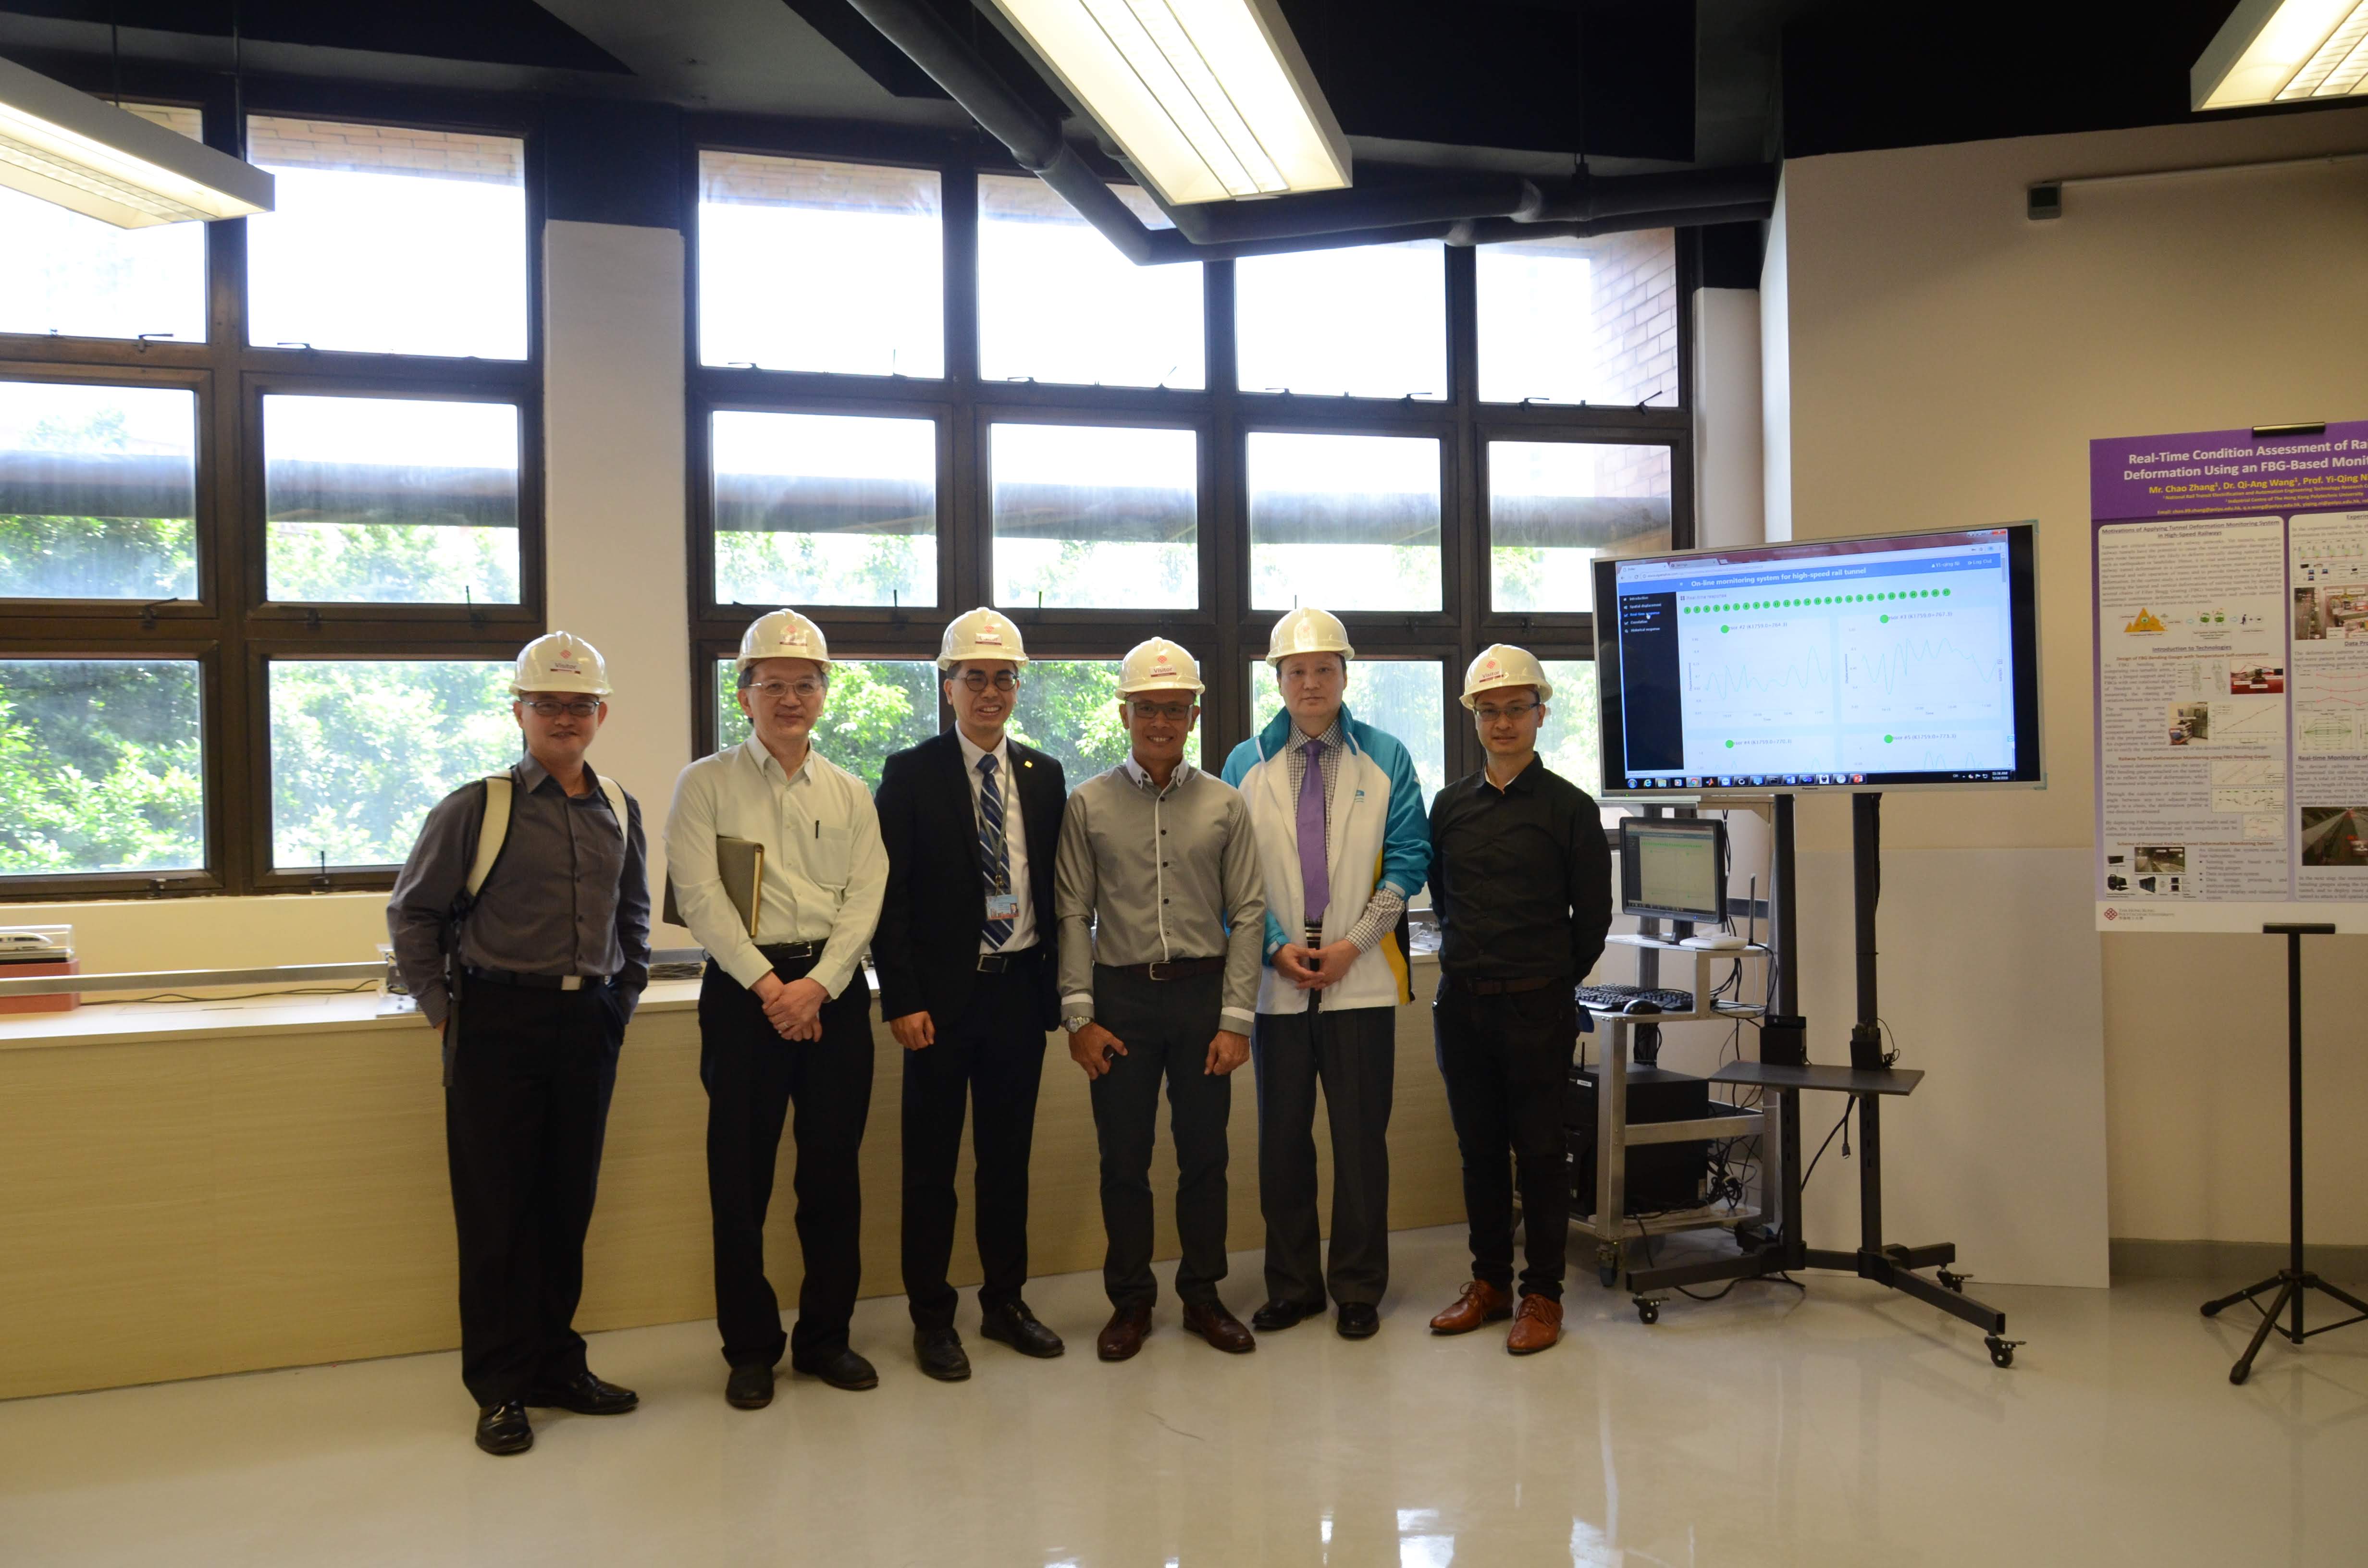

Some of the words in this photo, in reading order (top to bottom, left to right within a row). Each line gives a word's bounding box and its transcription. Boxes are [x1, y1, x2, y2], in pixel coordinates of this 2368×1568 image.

[2129, 452, 2190, 464] Real-Time
[2193, 447, 2253, 460] Condition
[2256, 442, 2331, 456] Assessment
[2334, 440, 2348, 451] of
[2351, 438, 2368, 450] Ra
[2124, 467, 2201, 480] Deformation
[2205, 465, 2239, 476] Using
[2242, 464, 2257, 473] an
[2261, 458, 2328, 472] FBG-Based
[2165, 485, 2187, 493] Chao
[2237, 480, 2268, 489] Qi-Ang
[2303, 476, 2323, 484] Prof.
[2326, 475, 2359, 483] Yi-Qing
[1716, 576, 1755, 586] mornitoring
[1756, 575, 1779, 583] system
[1792, 570, 1830, 580] high-speed
[1831, 568, 1843, 576] rail
